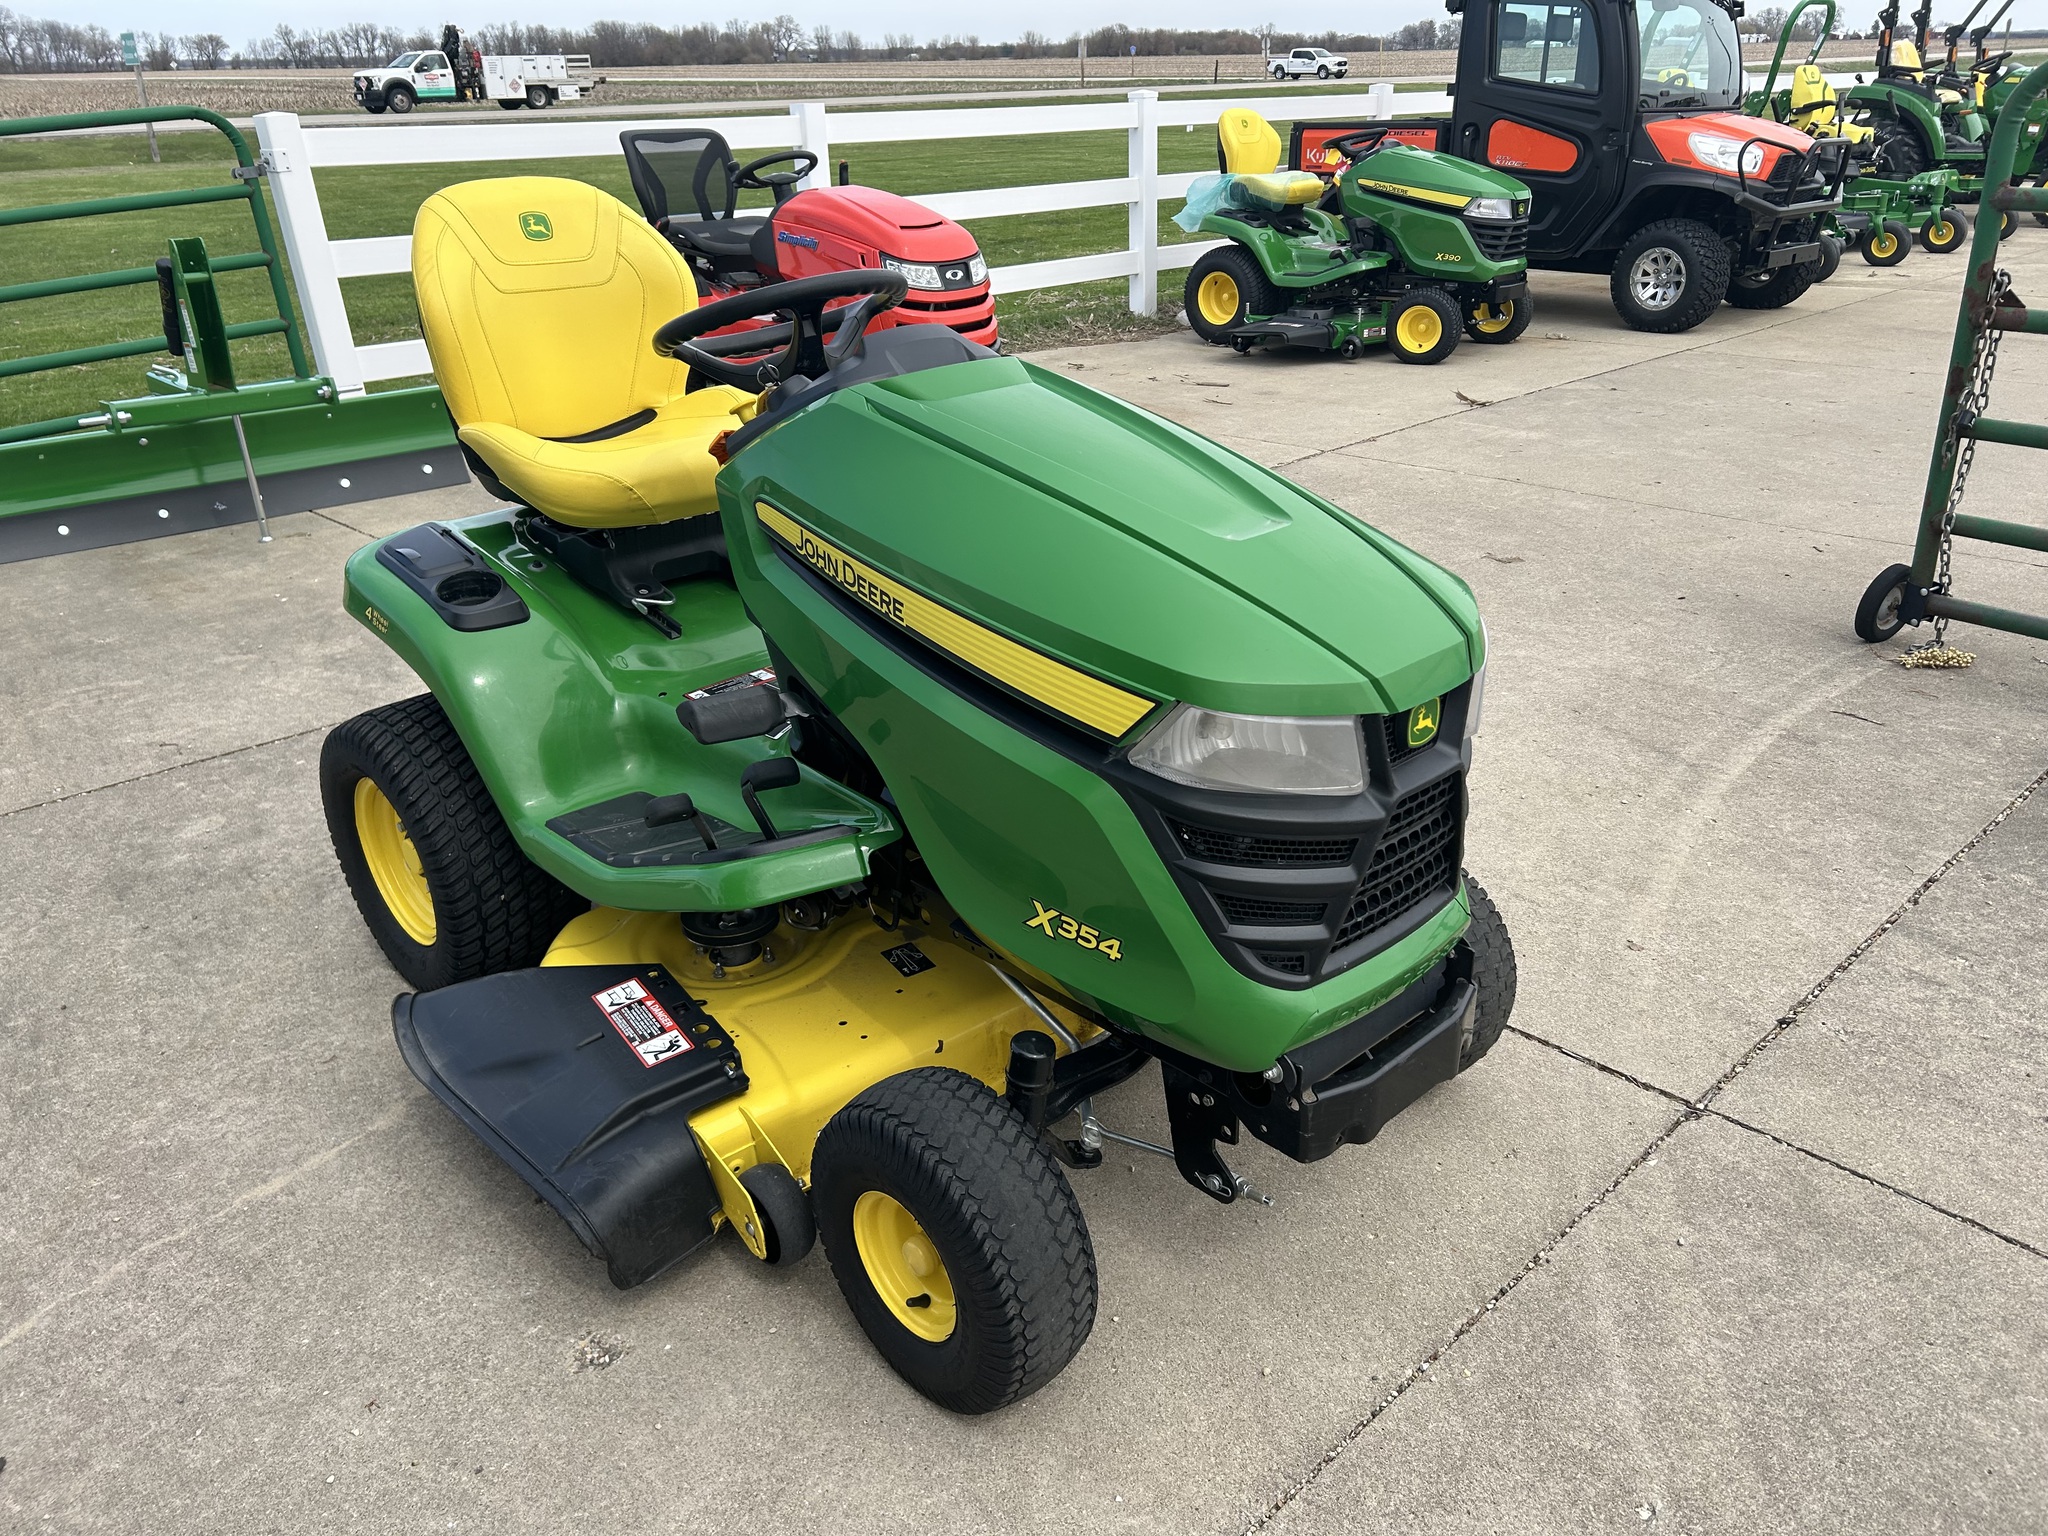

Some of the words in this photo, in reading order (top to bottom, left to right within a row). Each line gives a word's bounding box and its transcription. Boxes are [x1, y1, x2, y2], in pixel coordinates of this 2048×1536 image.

[1372, 182, 1389, 192] JOHN
[1388, 184, 1409, 196] DEERE
[778, 231, 819, 251] Simplicity
[1435, 252, 1461, 262] X390
[795, 528, 840, 580] JOHN
[842, 559, 906, 624] DEERE
[365, 606, 372, 621] 4
[1024, 898, 1123, 961] X354
[649, 1004, 674, 1028] DANGER
